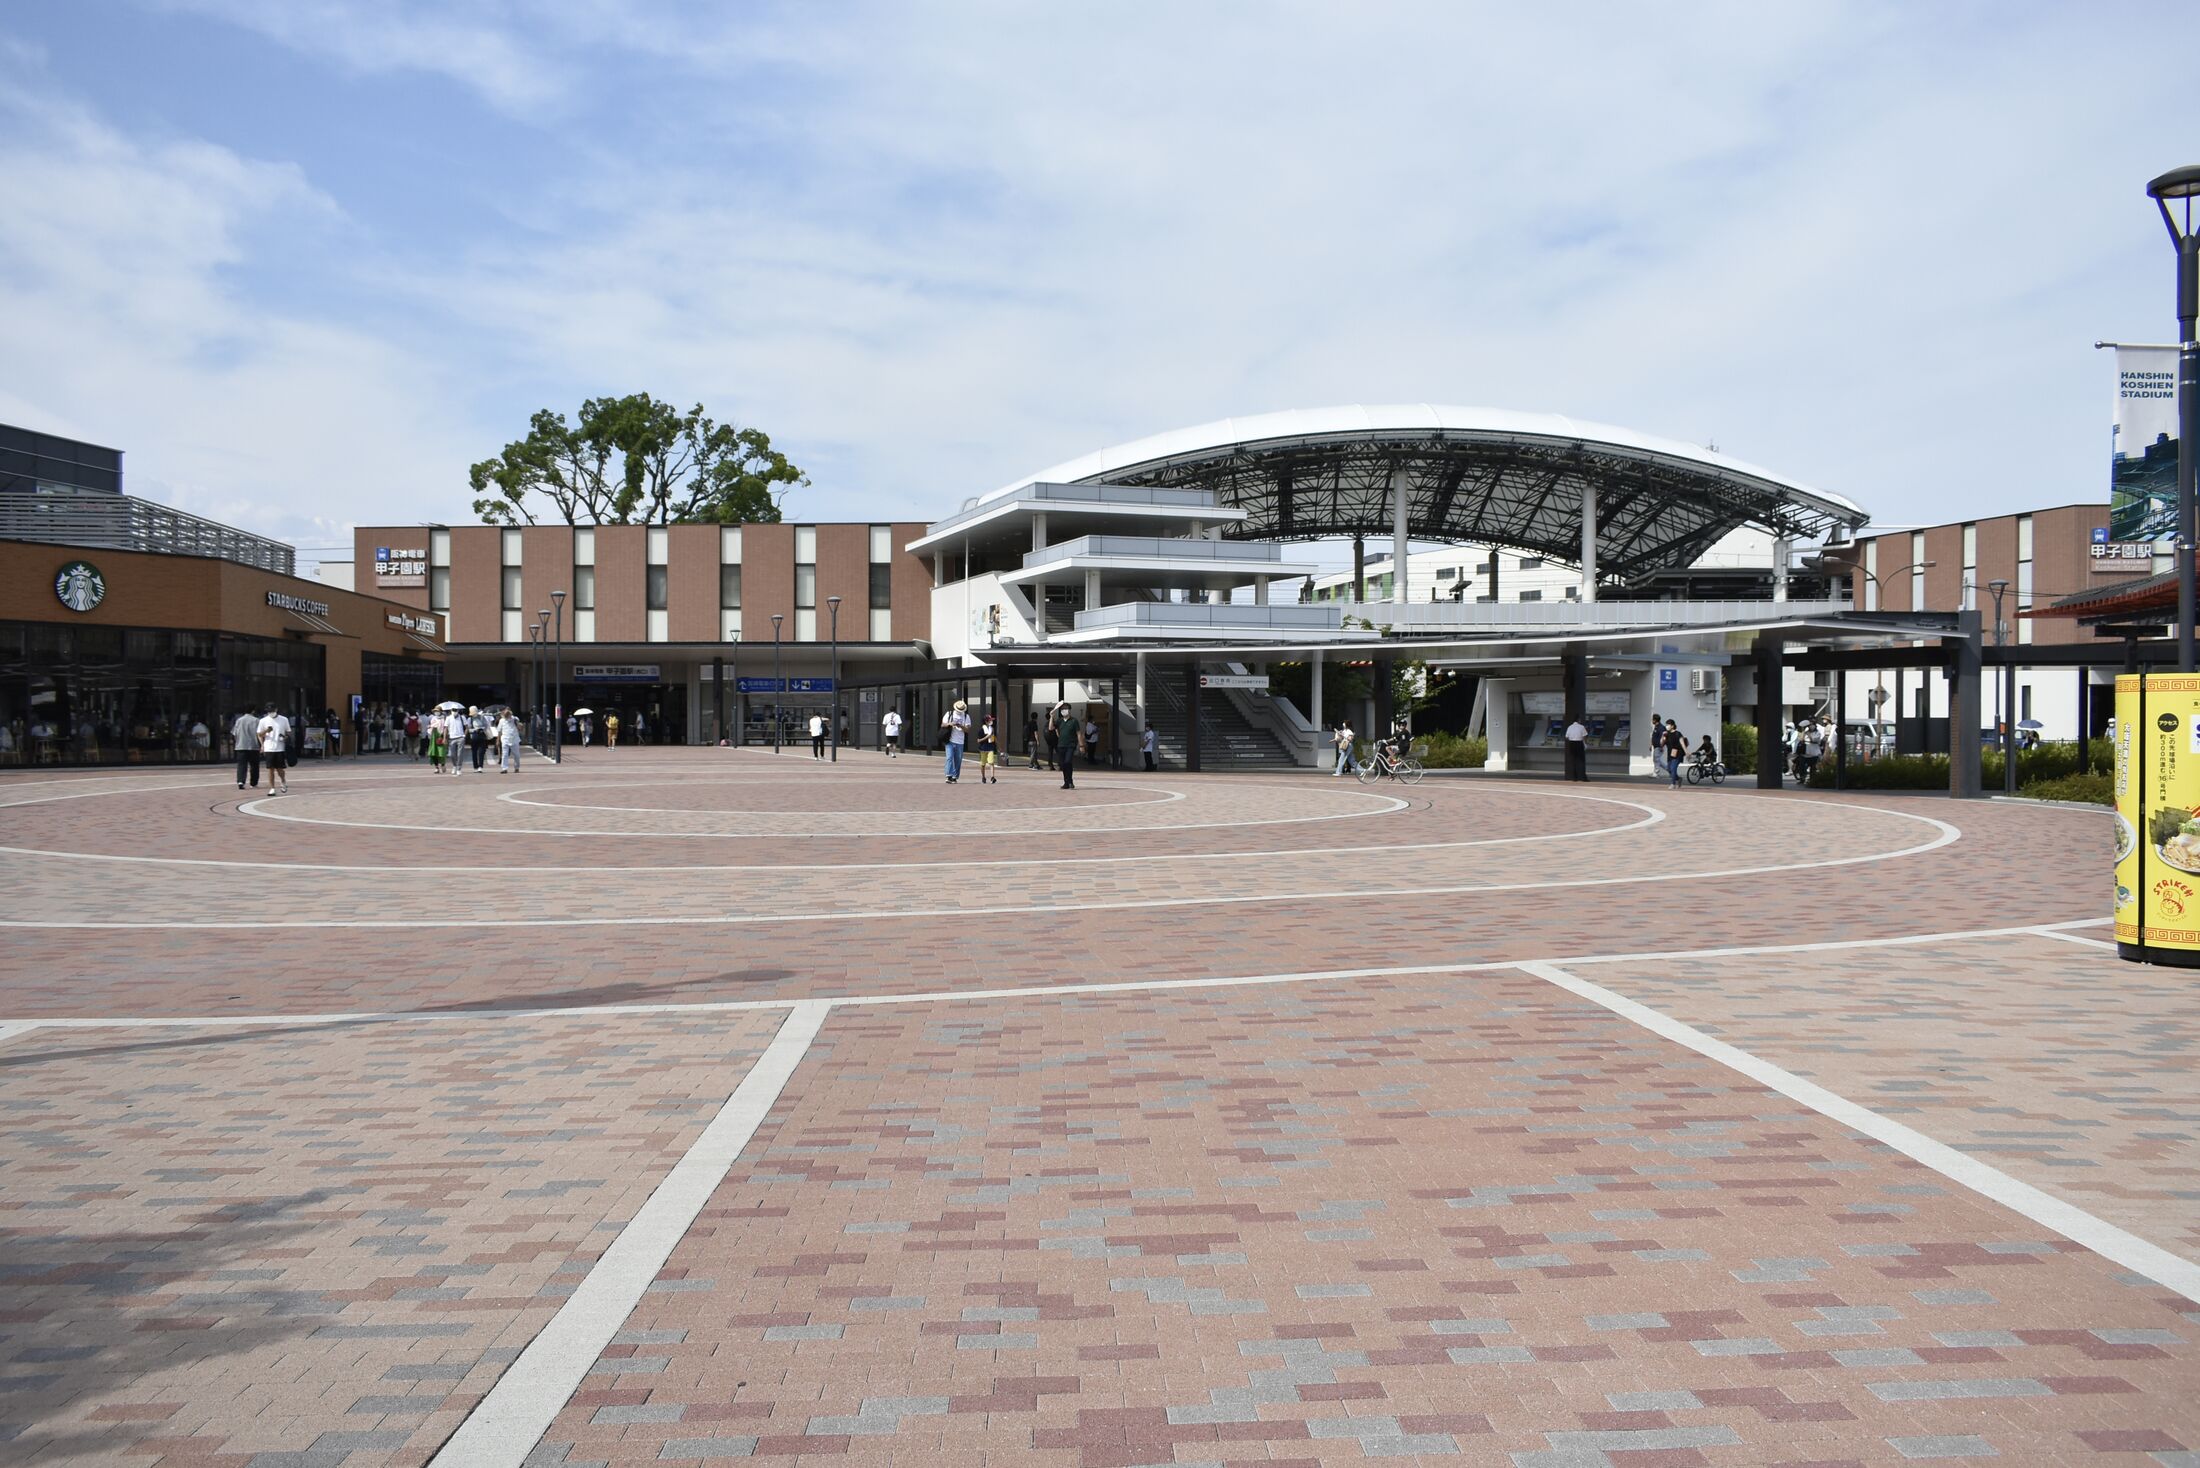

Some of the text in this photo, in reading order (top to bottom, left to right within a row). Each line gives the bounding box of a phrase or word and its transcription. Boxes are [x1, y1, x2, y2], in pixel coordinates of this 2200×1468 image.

[2121, 372, 2174, 380] HANSHIN
[2121, 381, 2174, 389] KOSHIEN
[2121, 391, 2174, 399] STADIUM
[390, 549, 426, 559] 阪神電車
[2091, 544, 2152, 558] 甲子園駅
[375, 562, 426, 575] 甲子園駅
[267, 591, 329, 616] STARBUCKS COFFEE
